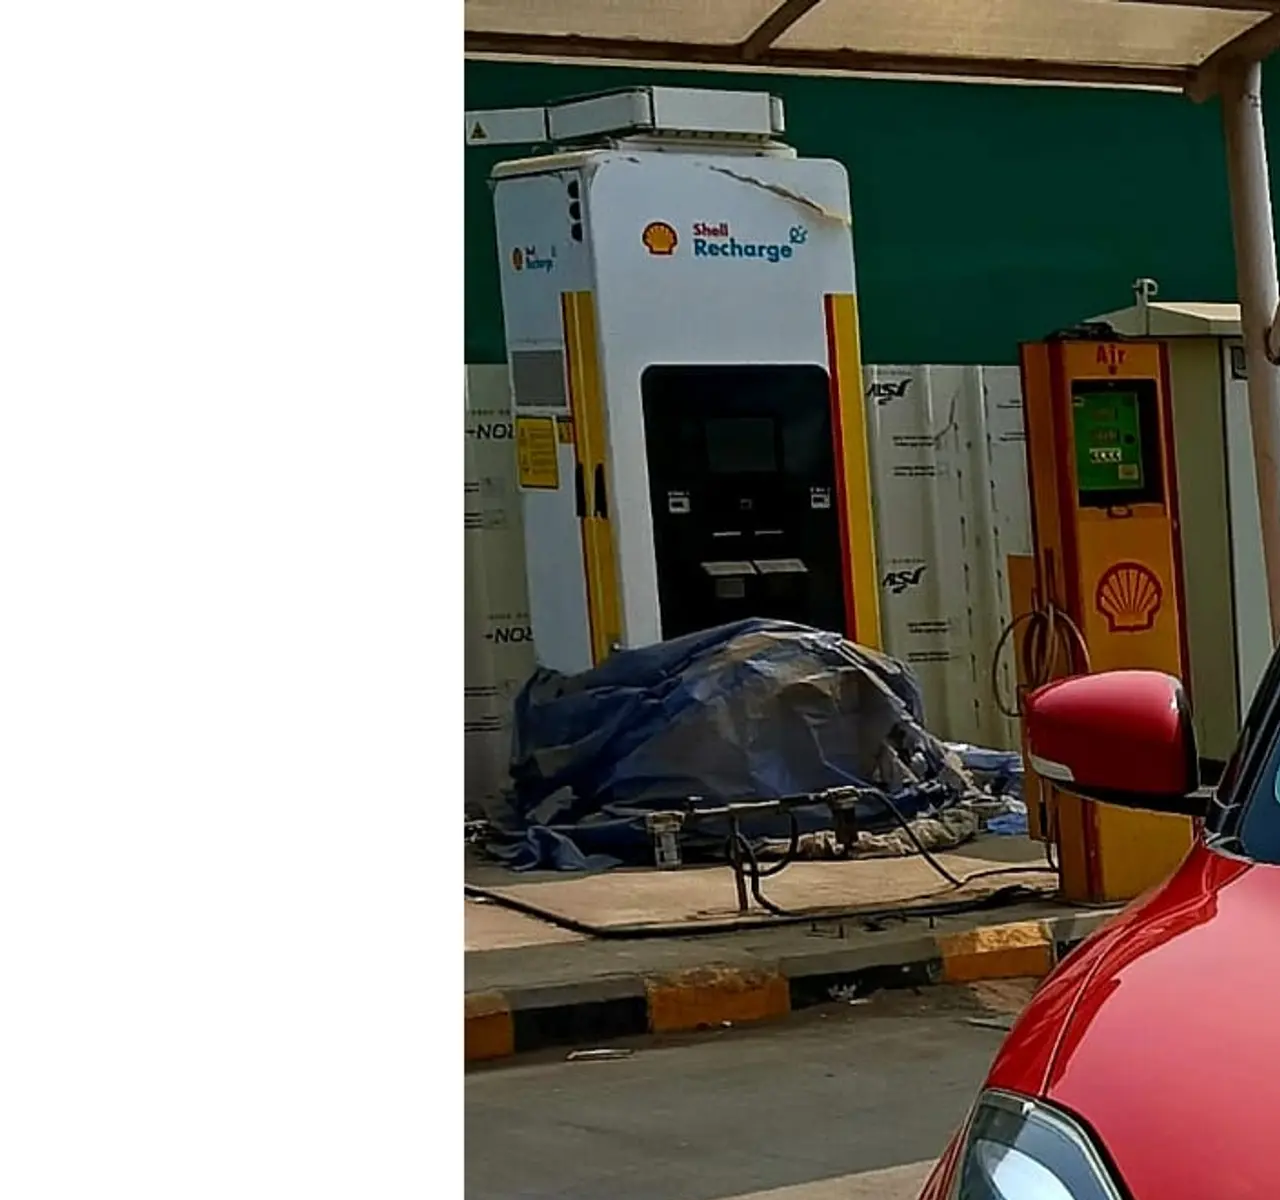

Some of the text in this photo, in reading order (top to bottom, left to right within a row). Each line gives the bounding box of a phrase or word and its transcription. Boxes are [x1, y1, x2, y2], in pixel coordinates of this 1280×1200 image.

[692, 222, 729, 237] Shell
[694, 237, 793, 263] Recharge
[1096, 343, 1126, 365] Air
